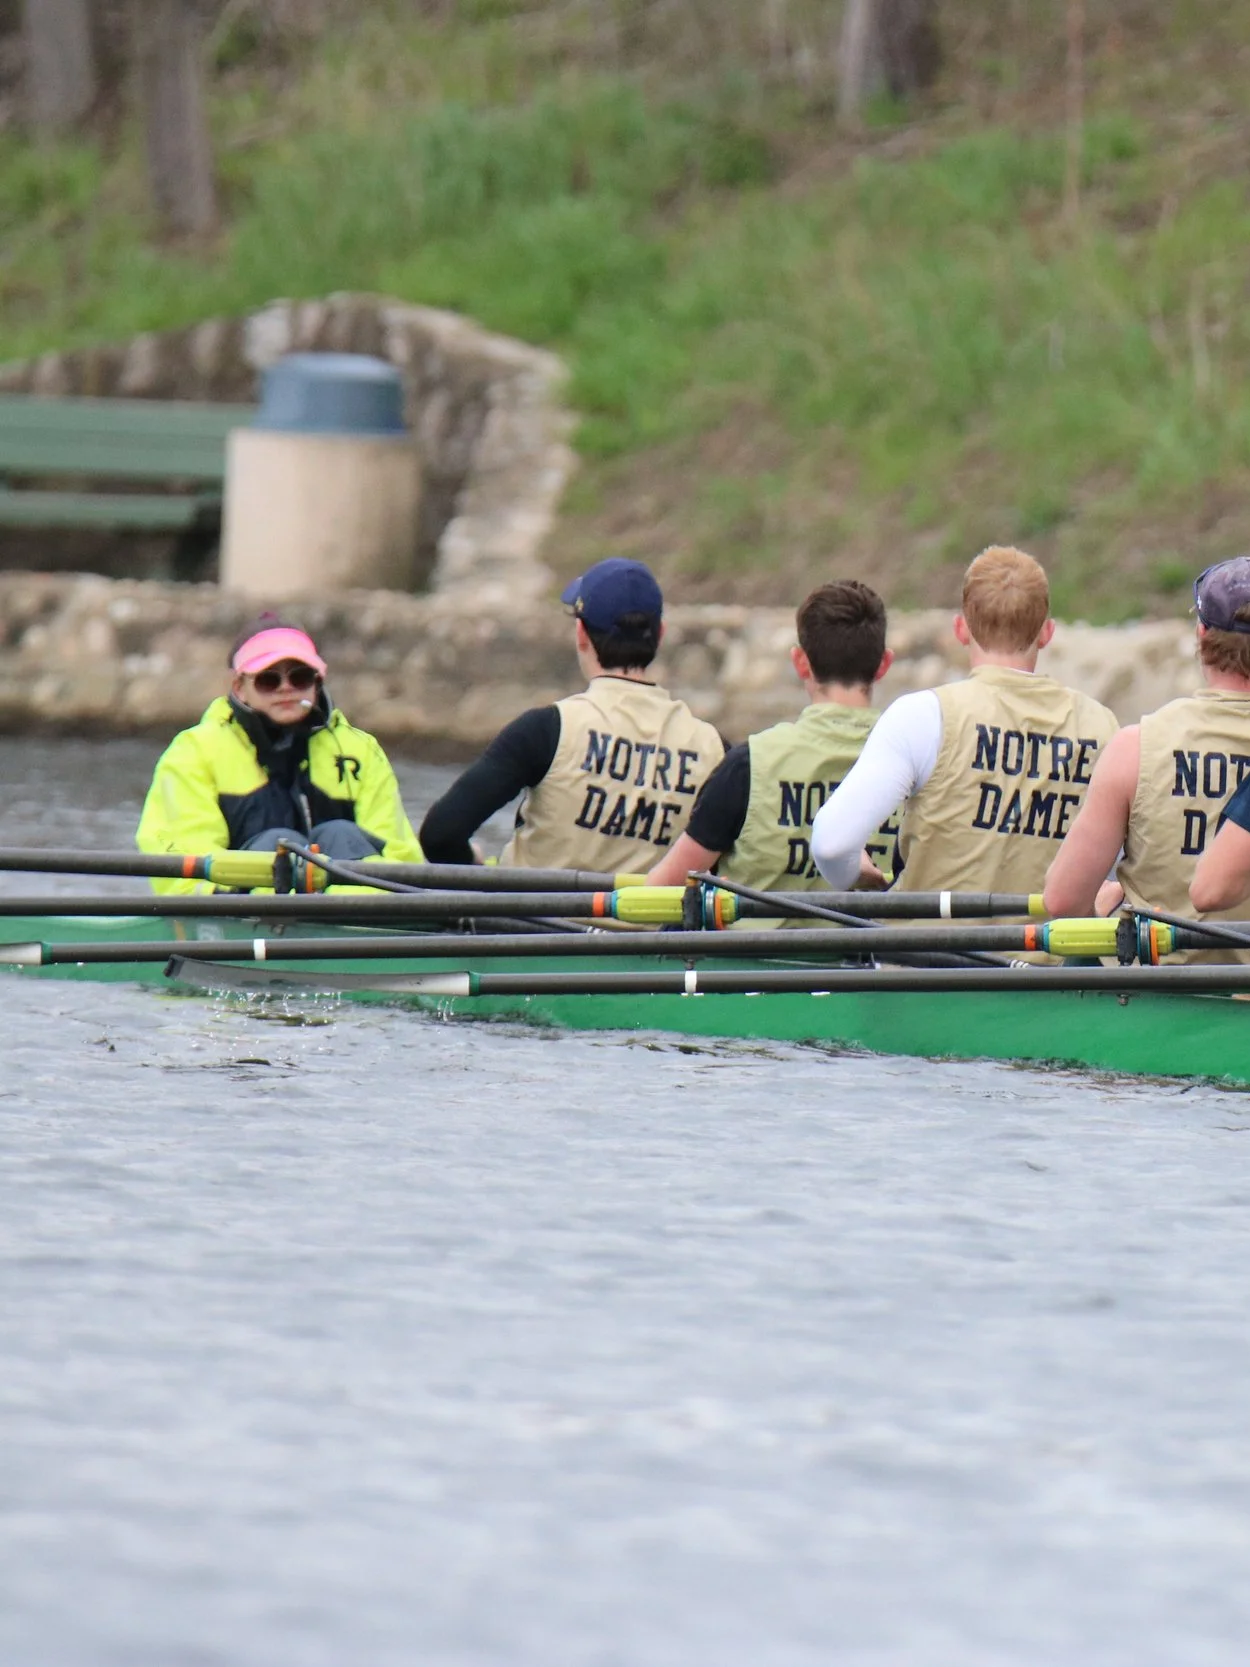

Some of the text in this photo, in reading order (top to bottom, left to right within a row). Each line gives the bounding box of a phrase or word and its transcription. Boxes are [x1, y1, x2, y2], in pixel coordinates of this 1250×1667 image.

[580, 729, 698, 794] NOTRE
[971, 723, 1098, 784] NOTRE
[574, 784, 682, 846] DAME
[972, 782, 1080, 840] DAME
